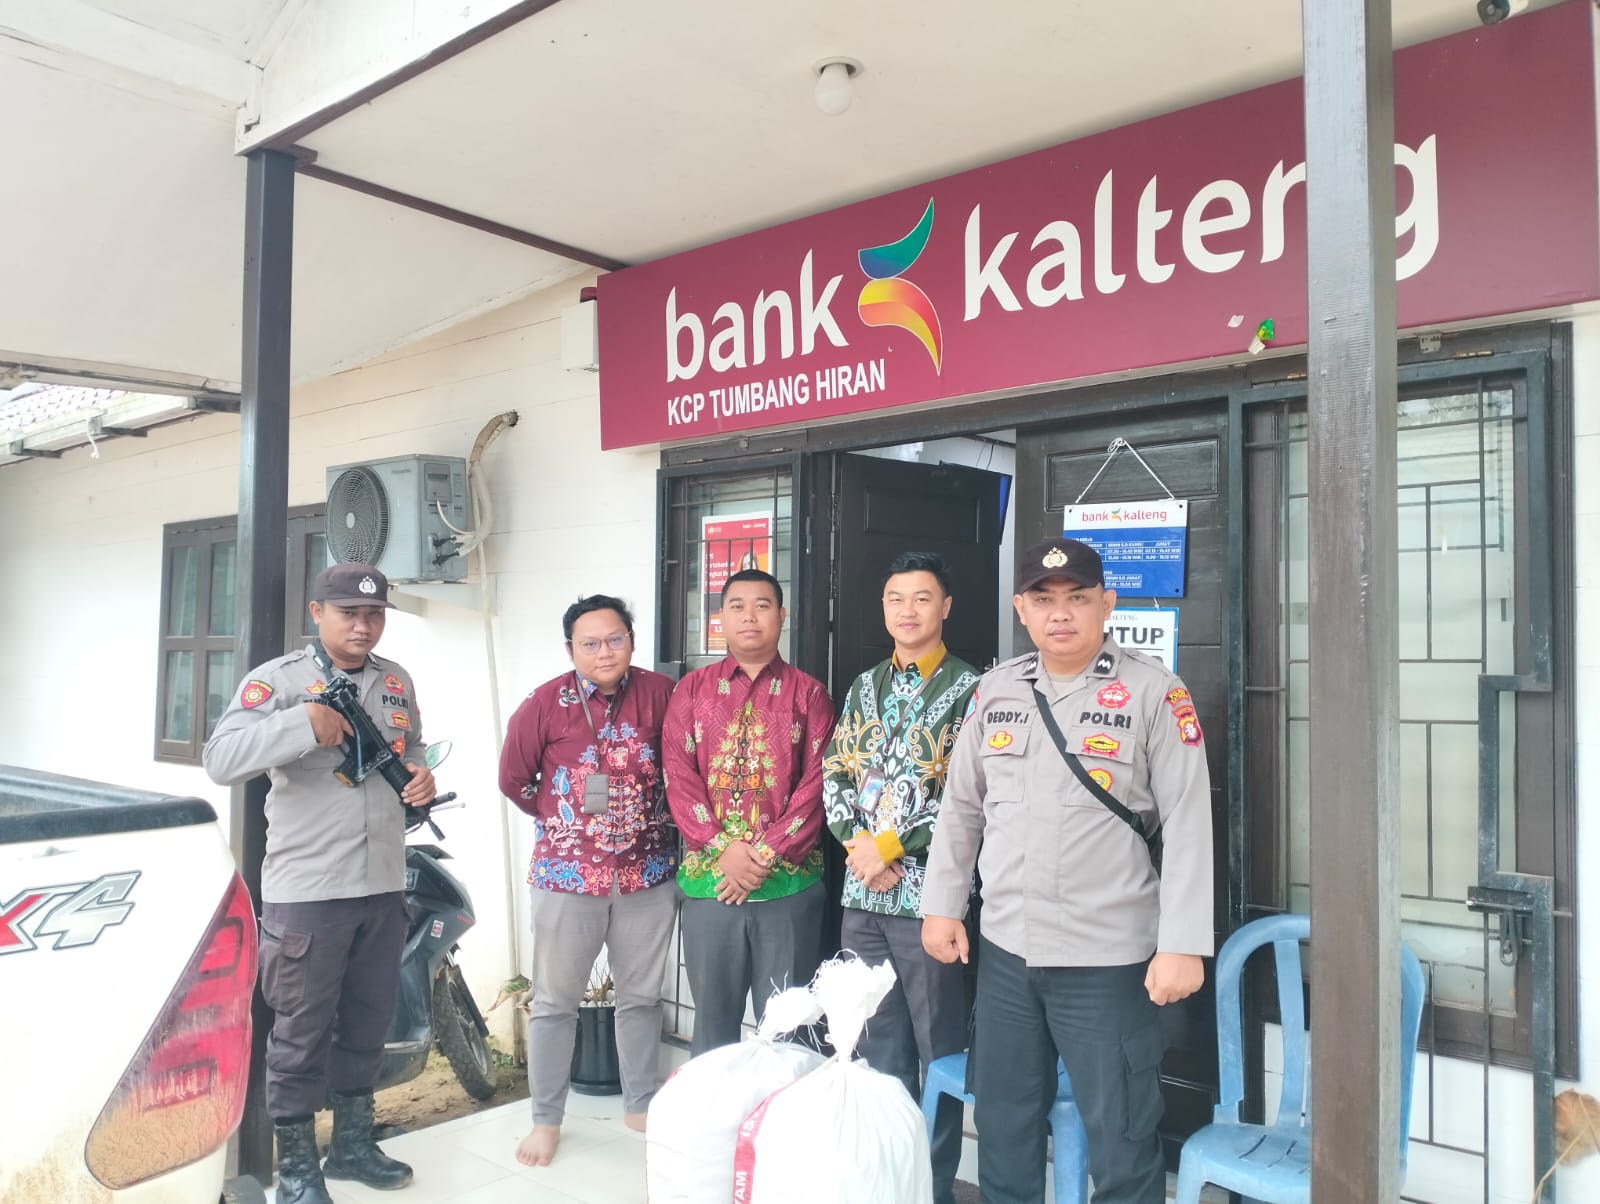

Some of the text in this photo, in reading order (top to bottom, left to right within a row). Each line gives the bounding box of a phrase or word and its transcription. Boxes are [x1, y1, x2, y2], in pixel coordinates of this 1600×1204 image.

[666, 248, 849, 382] bank
[668, 358, 885, 425] KCP TUMBANG HIRAN
[1082, 509, 1167, 522] bank kalteng
[1109, 626, 1165, 645] TUP
[1080, 711, 1132, 729] POLRI
